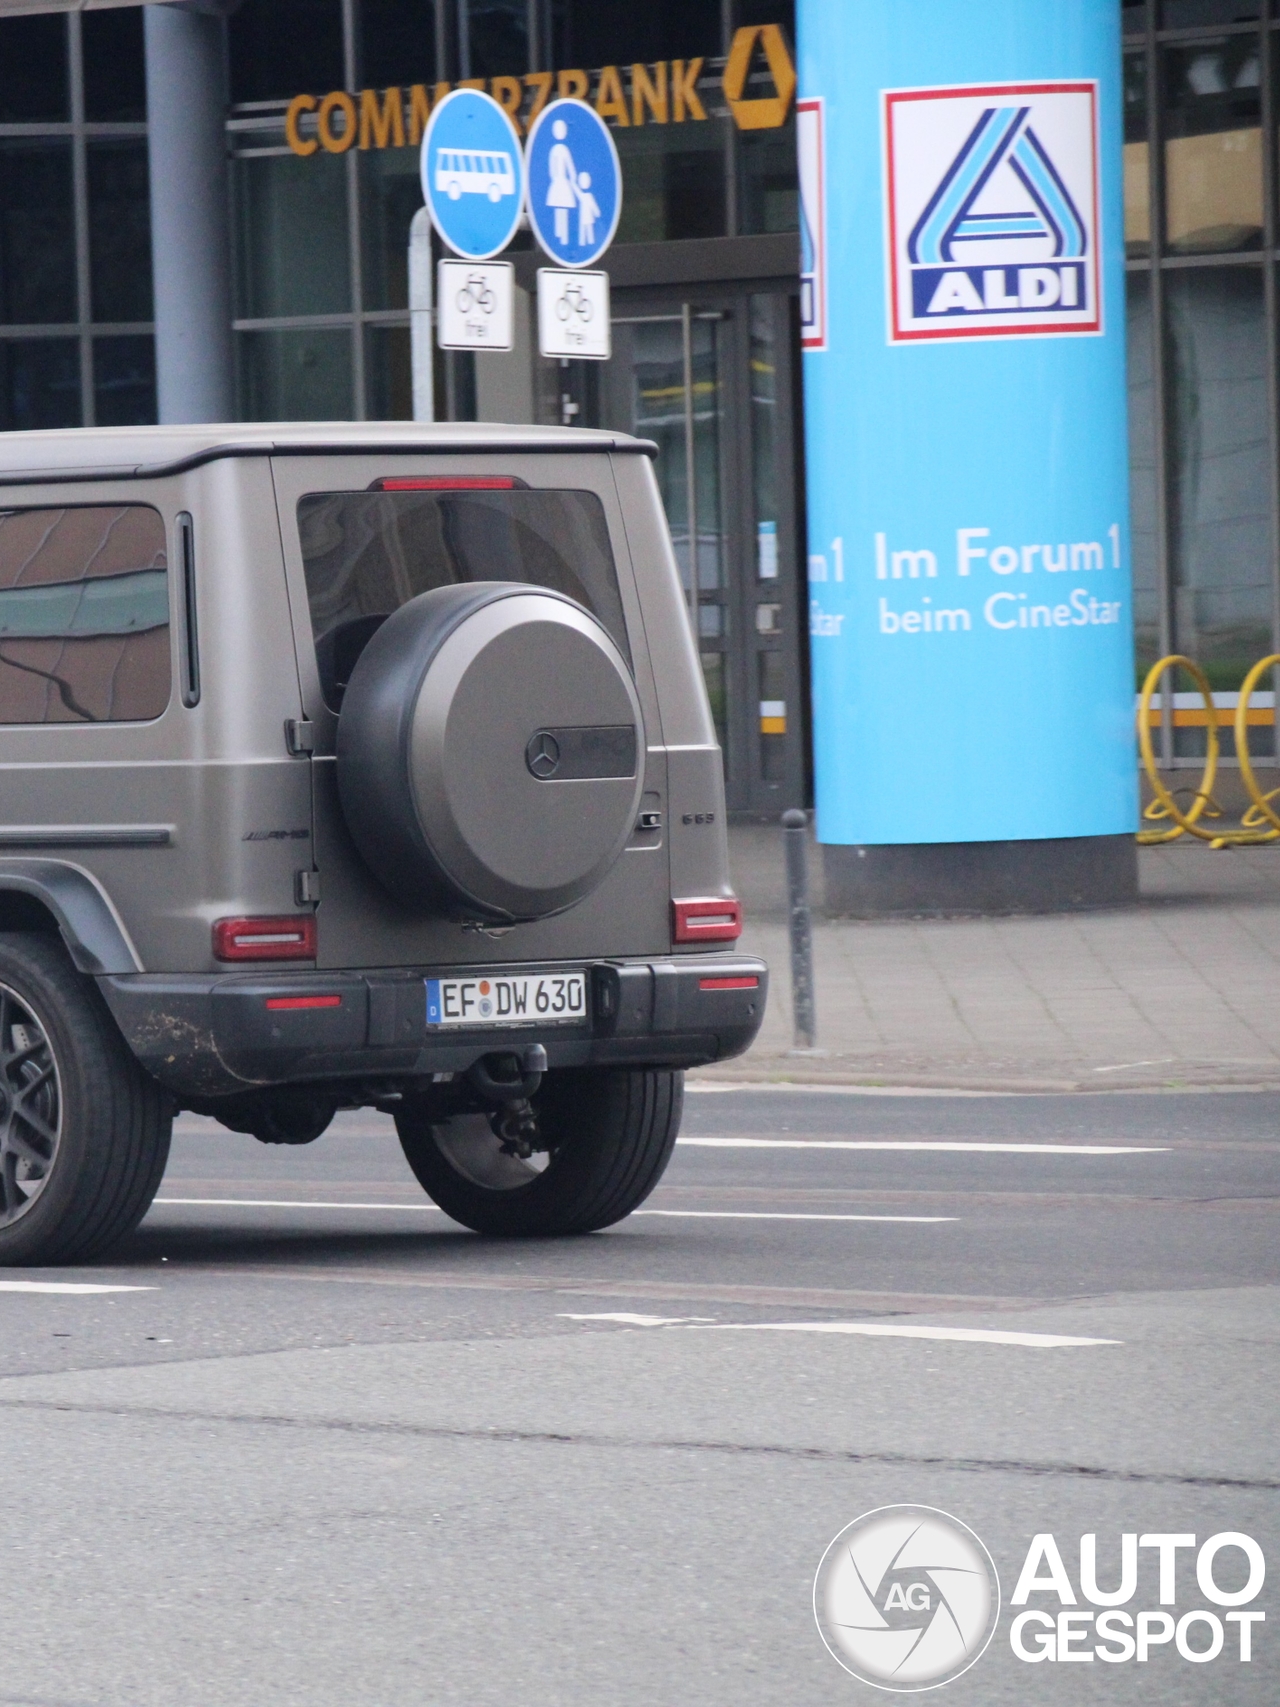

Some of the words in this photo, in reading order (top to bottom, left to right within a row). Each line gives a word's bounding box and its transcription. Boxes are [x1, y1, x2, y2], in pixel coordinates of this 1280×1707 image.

[285, 56, 708, 157] COMMRZBANK
[926, 266, 1078, 313] ALDI
[875, 531, 938, 580] Im
[956, 522, 1120, 577] Forum1
[879, 596, 972, 635] beim
[983, 588, 1122, 631] CineStar
[442, 983, 476, 1018] EF
[494, 981, 528, 1016] DW
[535, 978, 583, 1014] 630
